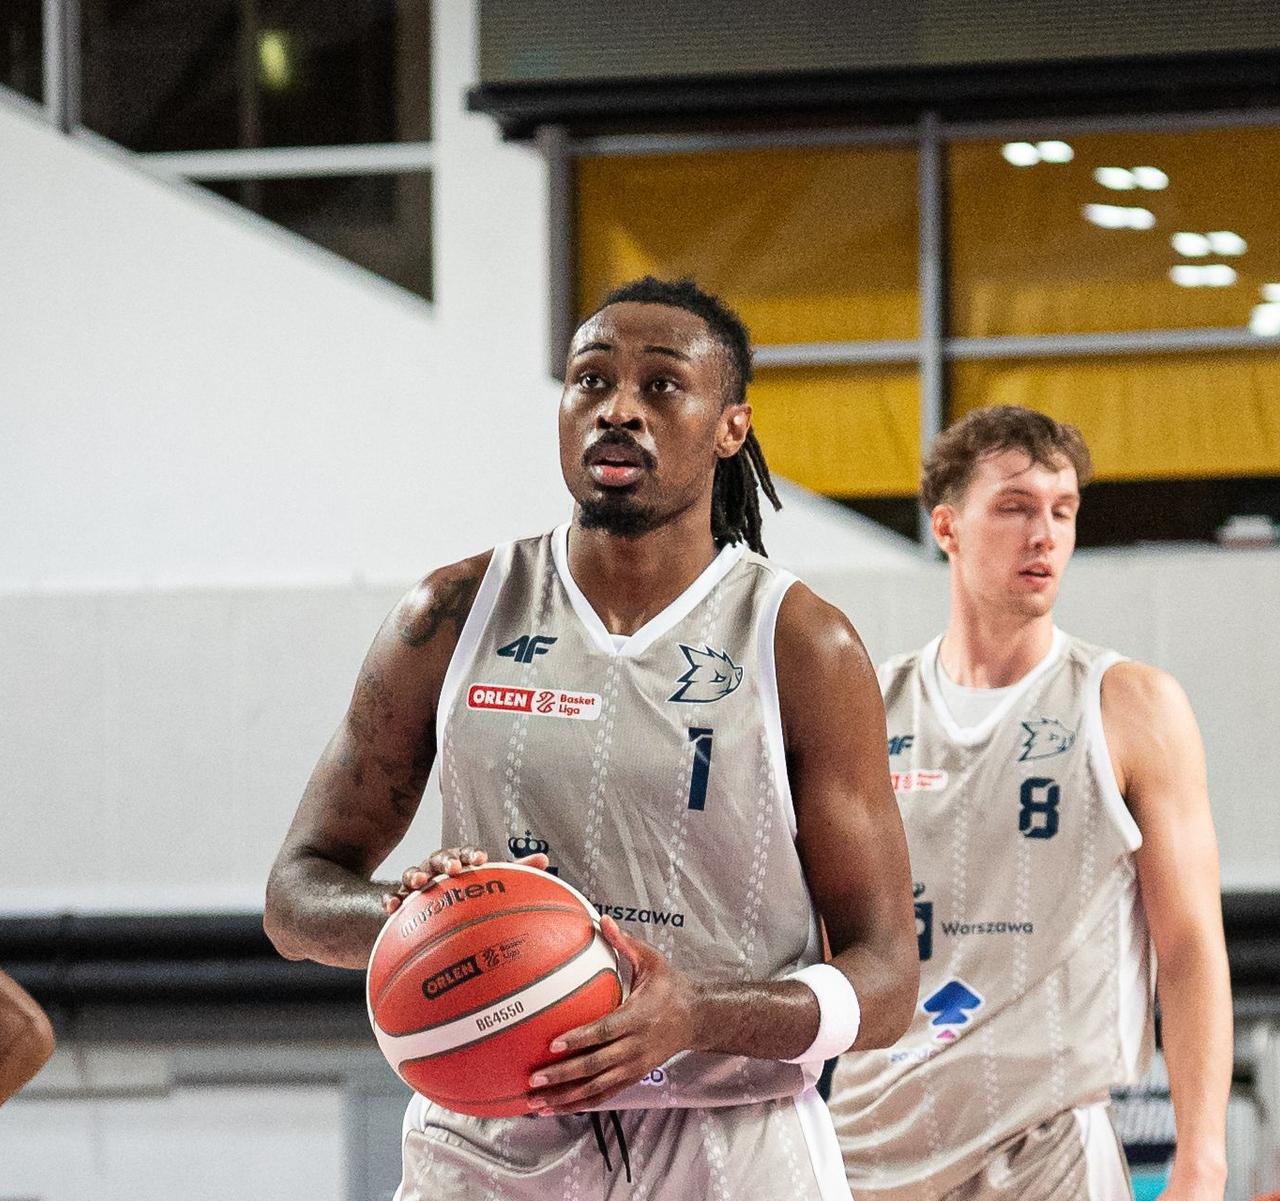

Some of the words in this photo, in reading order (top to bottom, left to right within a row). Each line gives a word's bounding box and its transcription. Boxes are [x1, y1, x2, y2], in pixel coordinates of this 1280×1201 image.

[473, 690, 528, 707] ORLEN
[558, 705, 580, 716] Liga
[560, 694, 596, 706] Basket
[687, 727, 714, 811] 1
[1019, 777, 1060, 839] 8
[588, 899, 685, 928] arszawa
[941, 920, 1034, 936] Warszawa
[427, 961, 476, 993] ORLEN
[475, 1000, 525, 1031] BG4550
